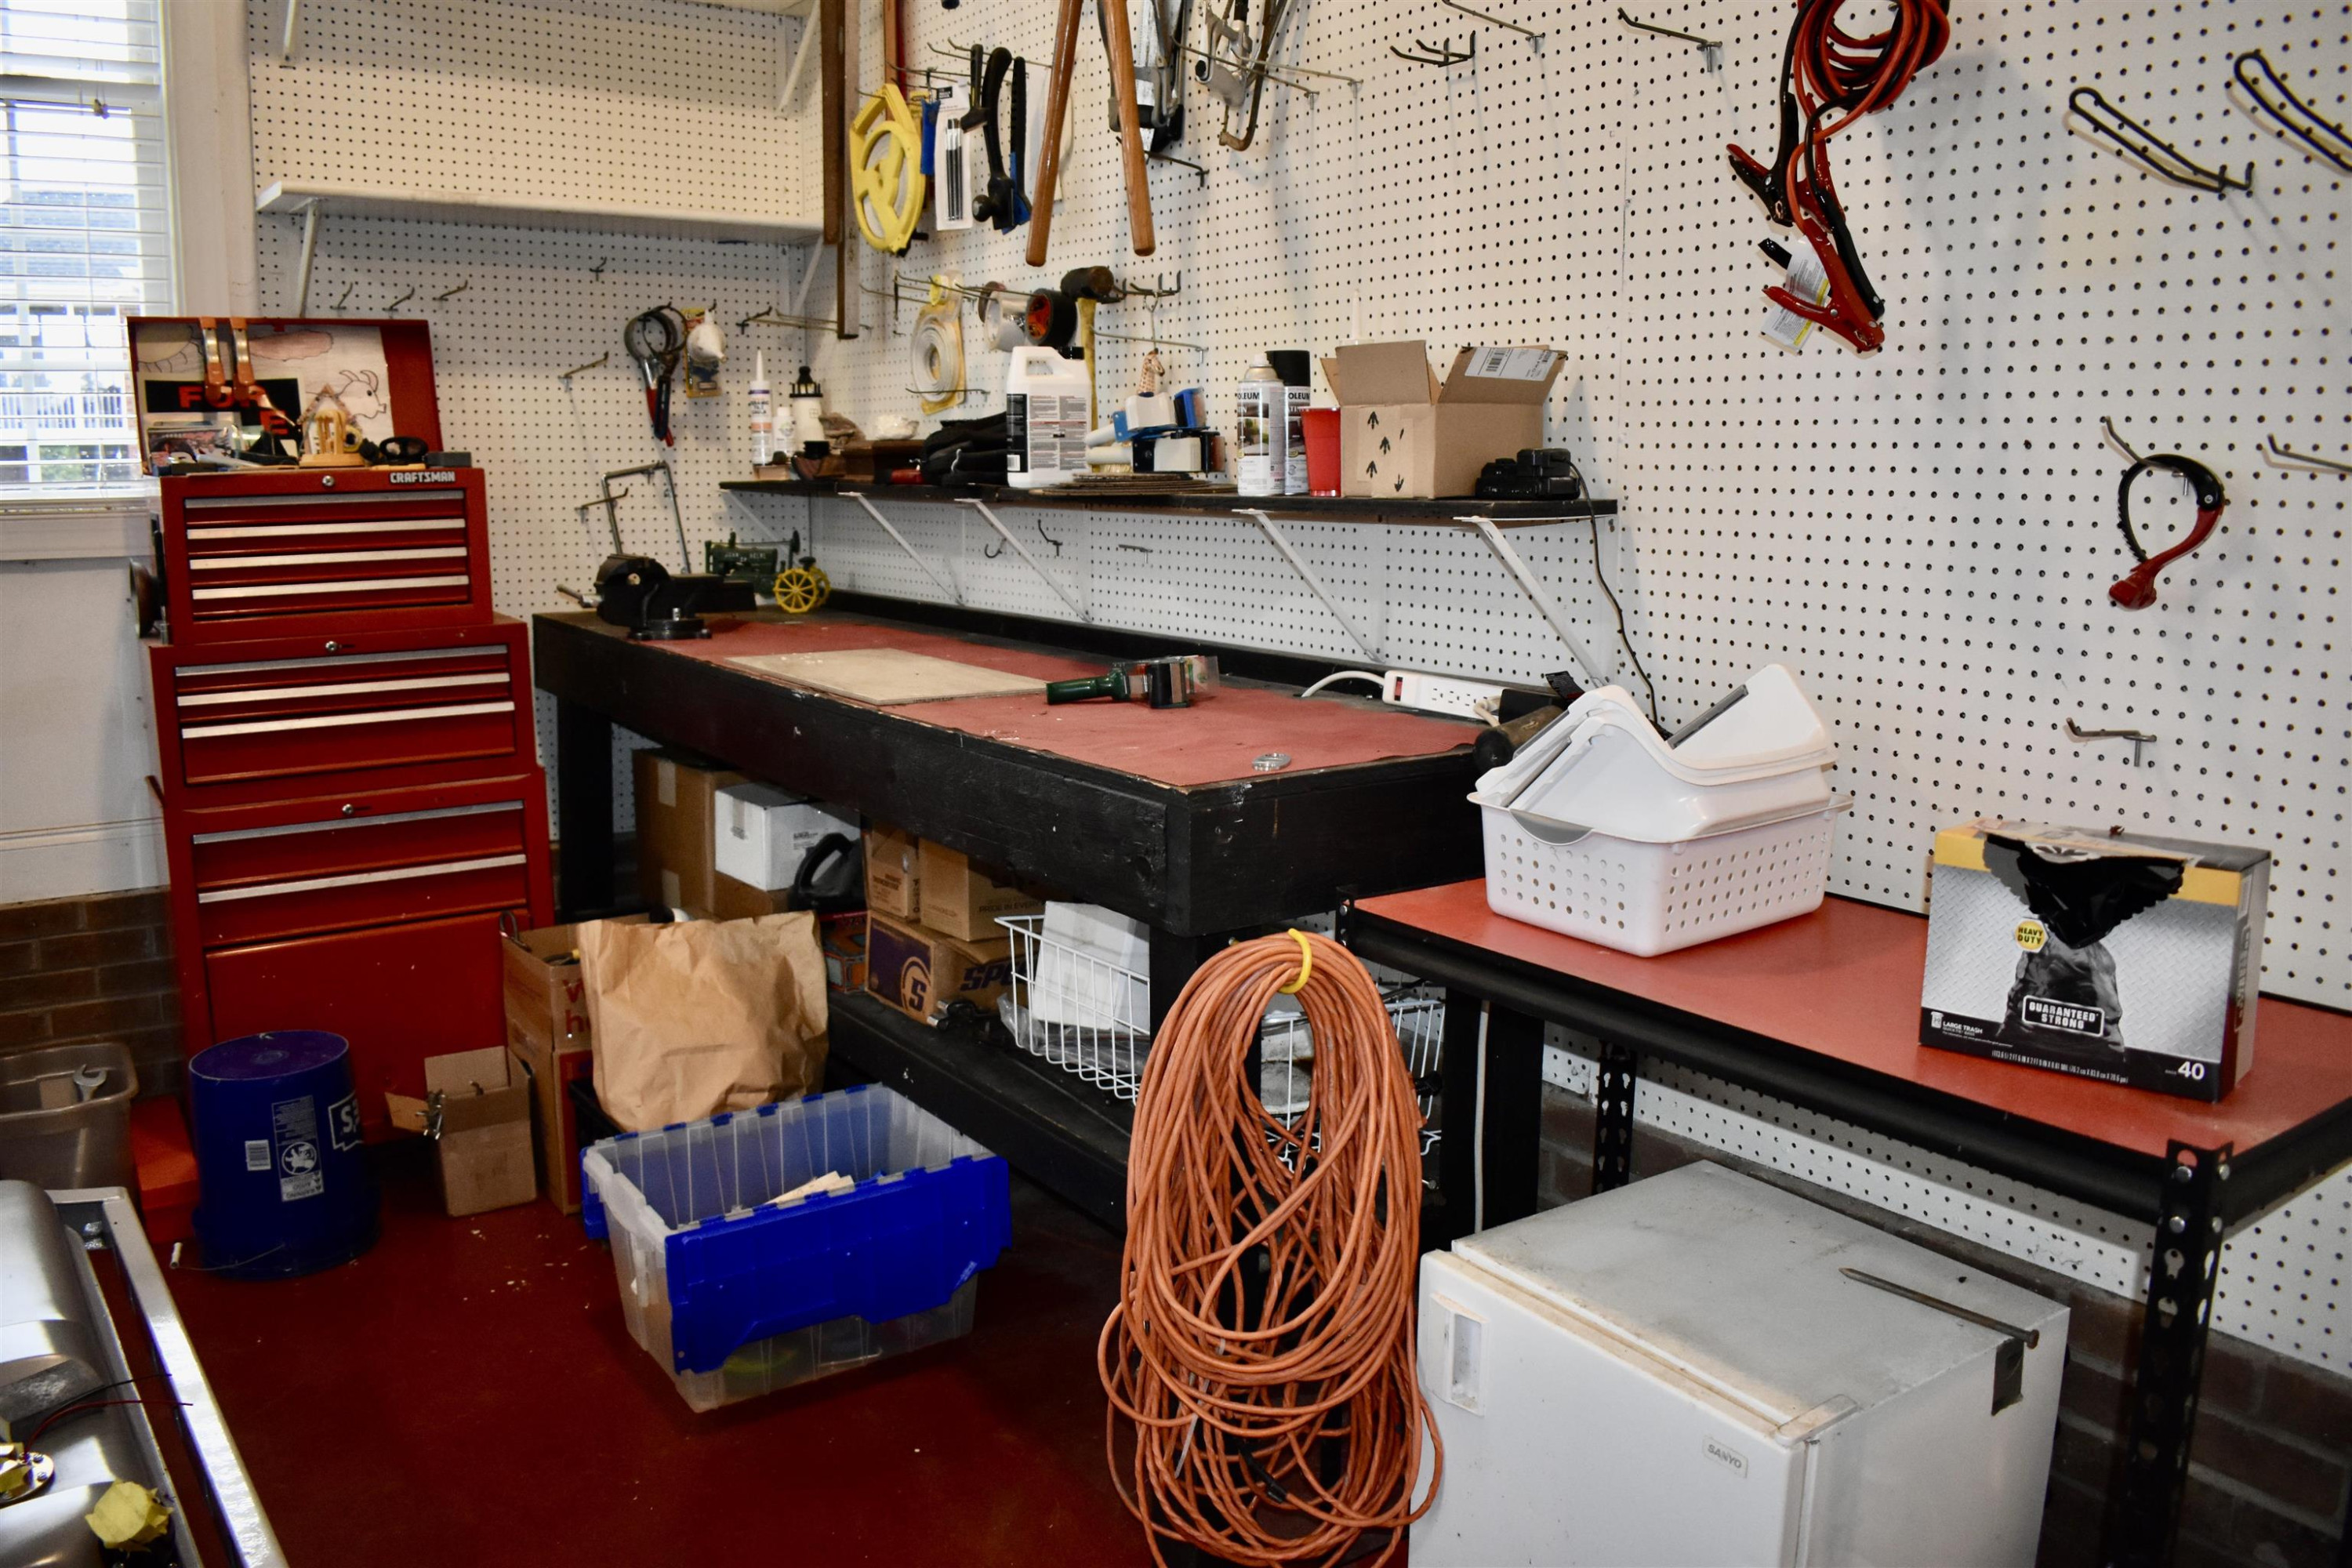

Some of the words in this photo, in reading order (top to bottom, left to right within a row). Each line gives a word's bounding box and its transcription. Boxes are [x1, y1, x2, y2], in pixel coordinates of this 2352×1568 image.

[390, 471, 456, 483] CRAFTSMAN
[2017, 934, 2041, 945] DUTY
[2018, 927, 2043, 937] HEAVY
[2029, 1001, 2096, 1023] GUARANTEED
[1943, 1021, 1962, 1031] LARGE
[1963, 1025, 1984, 1034] TRASH
[2041, 1013, 2085, 1030] STRONG
[2178, 1061, 2205, 1080] 40
[1708, 1444, 1742, 1468] SANYO
